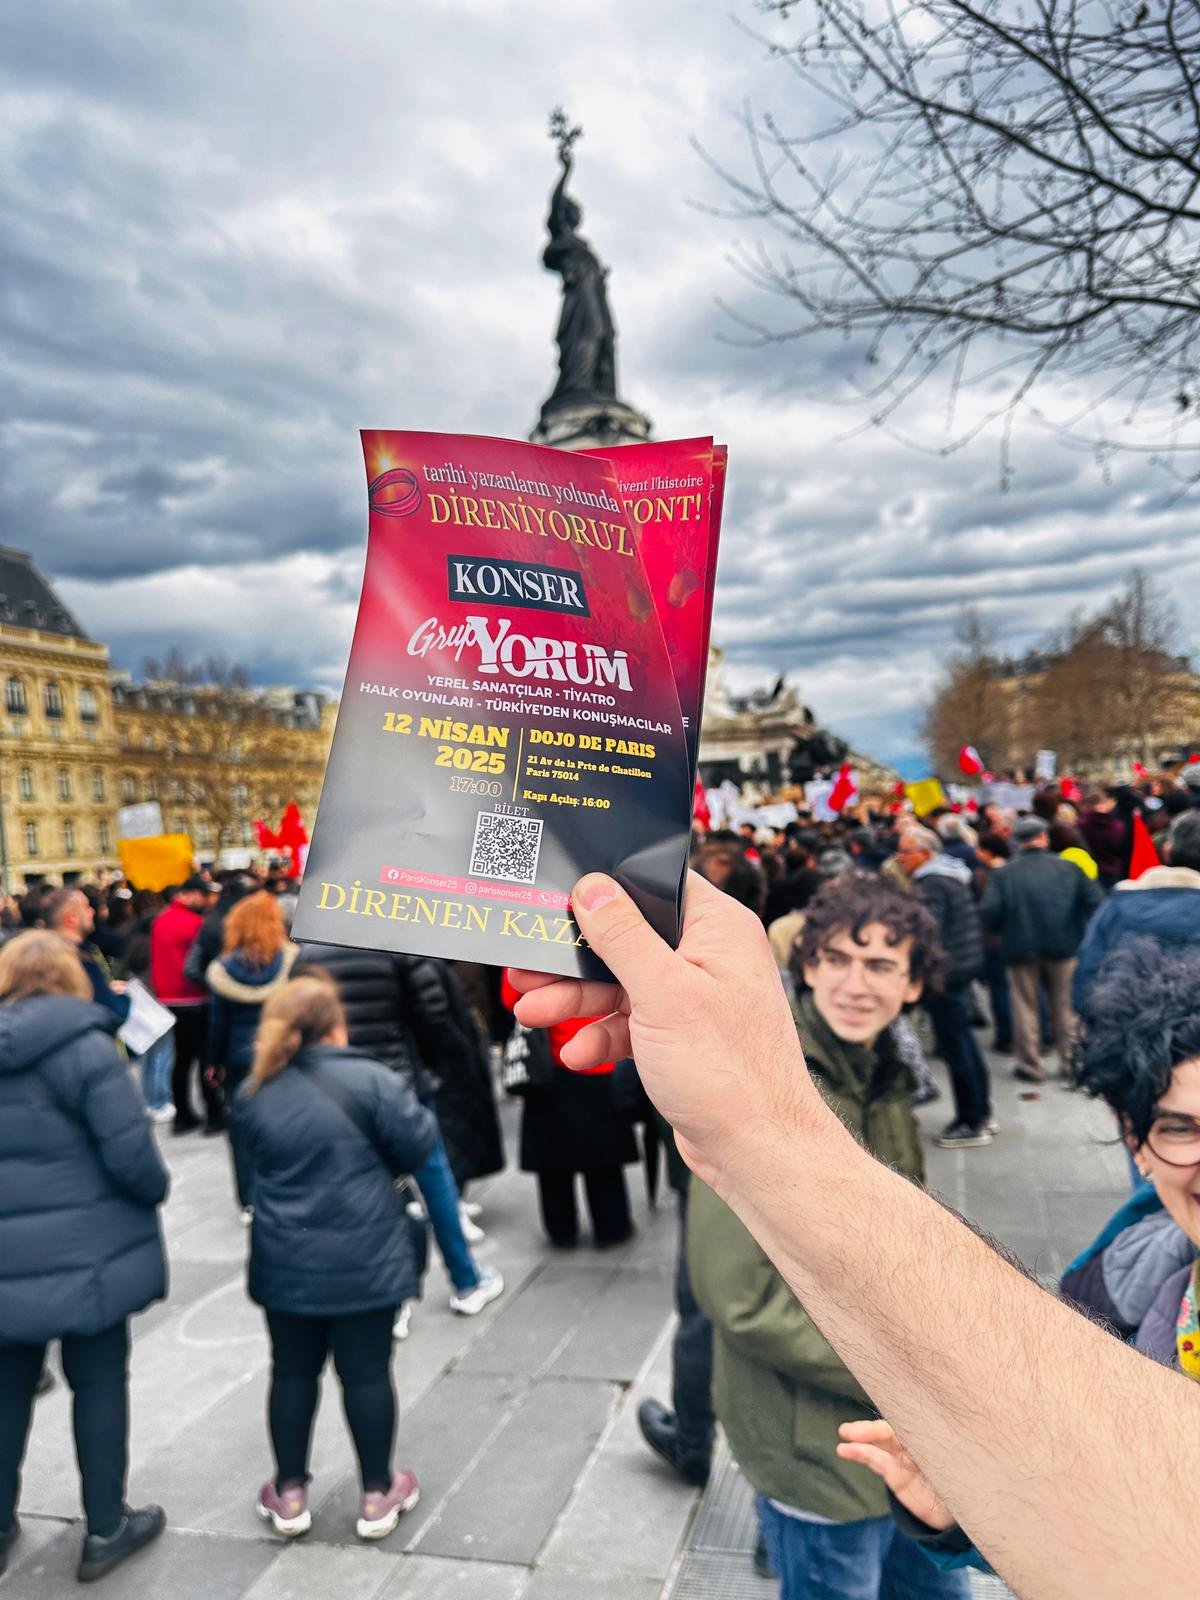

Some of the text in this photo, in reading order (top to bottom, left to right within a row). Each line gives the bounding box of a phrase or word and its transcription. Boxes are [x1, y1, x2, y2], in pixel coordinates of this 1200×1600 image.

[423, 463, 621, 513] tarihi yazanların yolunda
[617, 480, 648, 492] ivent
[652, 474, 703, 490] l'histoire
[427, 487, 635, 557] DİRENİYORUZ
[453, 562, 584, 608] KONSER
[407, 615, 633, 692] Grup YORUM
[427, 675, 469, 690] YEREL
[472, 680, 553, 698] SANATÇILAR
[563, 687, 616, 707] TİYATRO
[359, 682, 399, 698] HALK
[402, 689, 473, 708] OYUNLARI
[485, 698, 569, 718] TÜRKİYE'DEN
[573, 709, 672, 735] KONUŞMACILAR
[383, 712, 510, 748] 12 NİSAN
[529, 729, 656, 759] DOJO DE PARIS
[434, 745, 506, 775] 2025
[526, 767, 580, 782] Paris 75014
[527, 755, 652, 779] 21 Av de la Prte de Chatillon
[450, 775, 503, 797] 17:00
[523, 789, 548, 803] Kapı
[582, 796, 611, 810] 16:00
[494, 802, 530, 817] BİLET
[316, 880, 493, 933] DİRENEN
